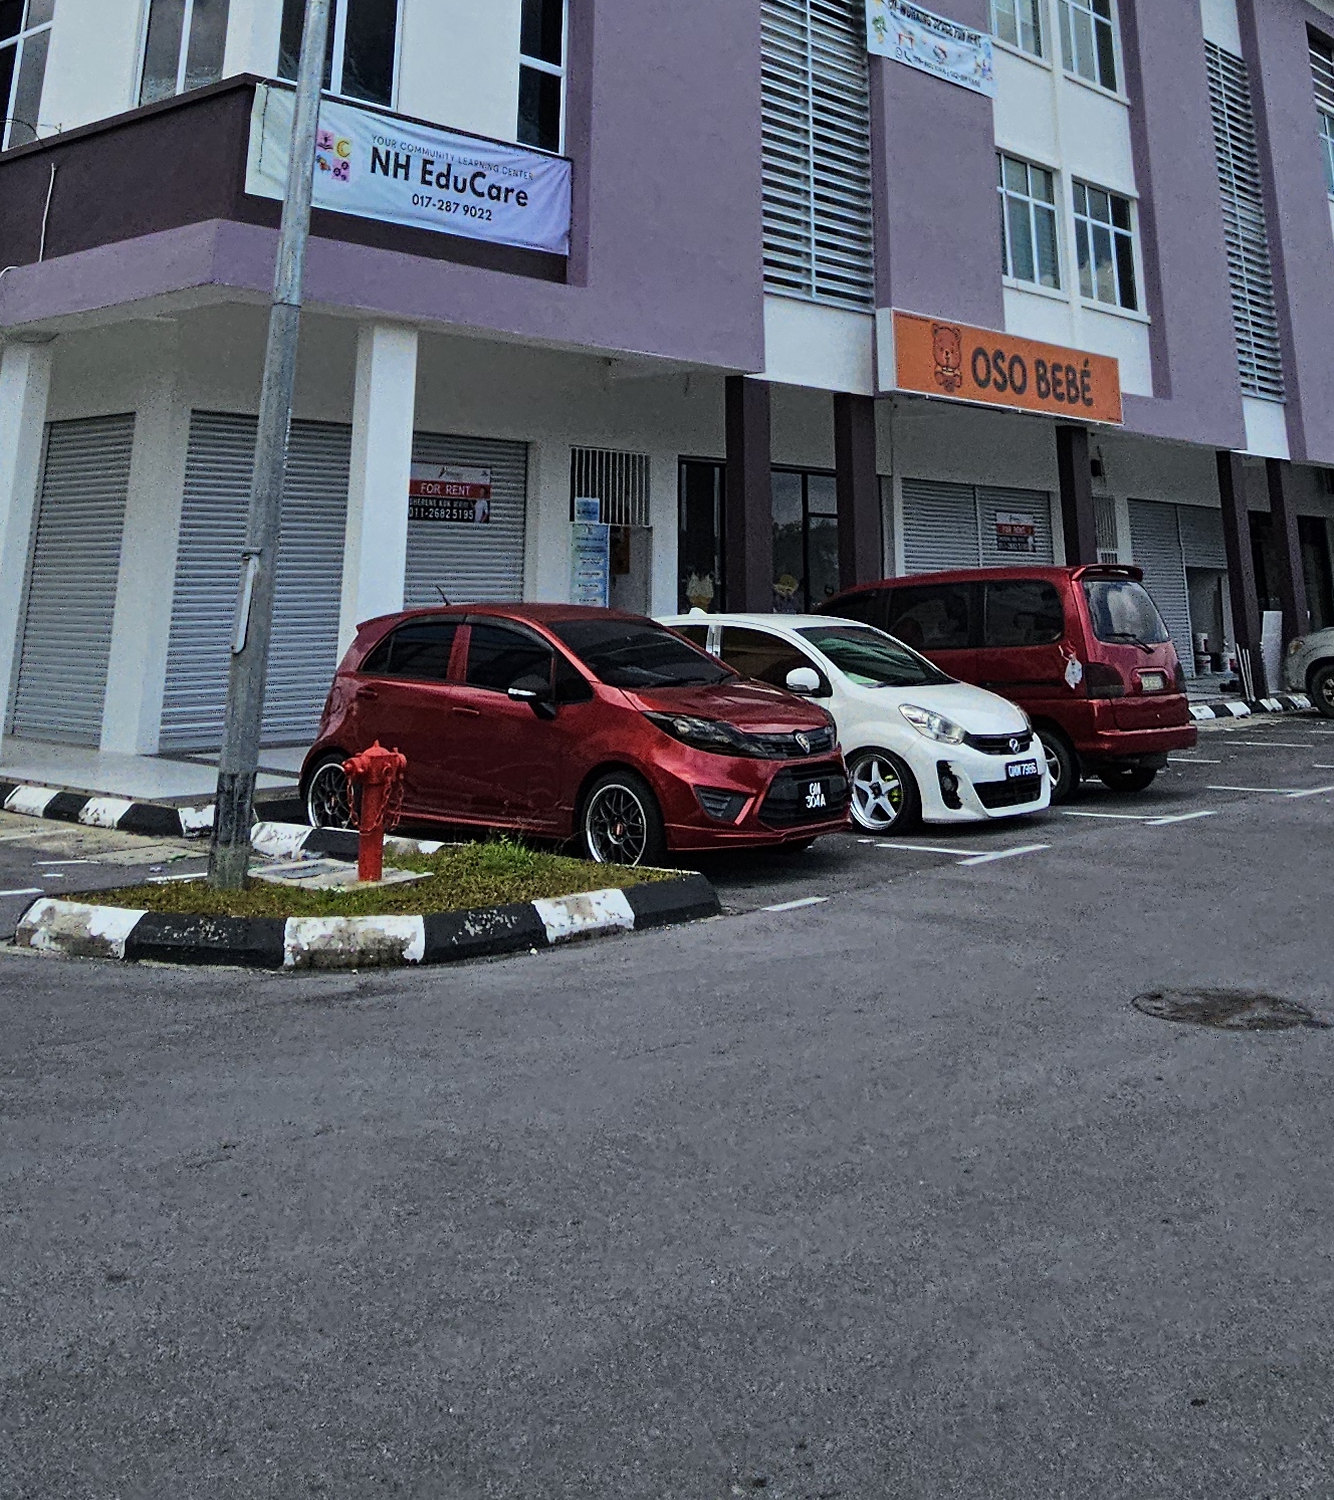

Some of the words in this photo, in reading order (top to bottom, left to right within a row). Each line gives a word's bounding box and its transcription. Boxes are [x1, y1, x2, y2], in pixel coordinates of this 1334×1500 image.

[372, 134, 397, 148] YOUR
[399, 142, 454, 161] COMMUNITY
[458, 156, 499, 173] LEARNING
[501, 166, 534, 180] CENTER
[370, 146, 411, 181] NH
[420, 158, 529, 207] EduCare
[412, 193, 460, 214] 017-287
[463, 204, 492, 221] 9022
[971, 347, 1027, 395] OSO
[1034, 357, 1094, 407] BEBÉ
[420, 483, 441, 495] FOR
[446, 484, 472, 496] RENT
[452, 509, 474, 520] 5195
